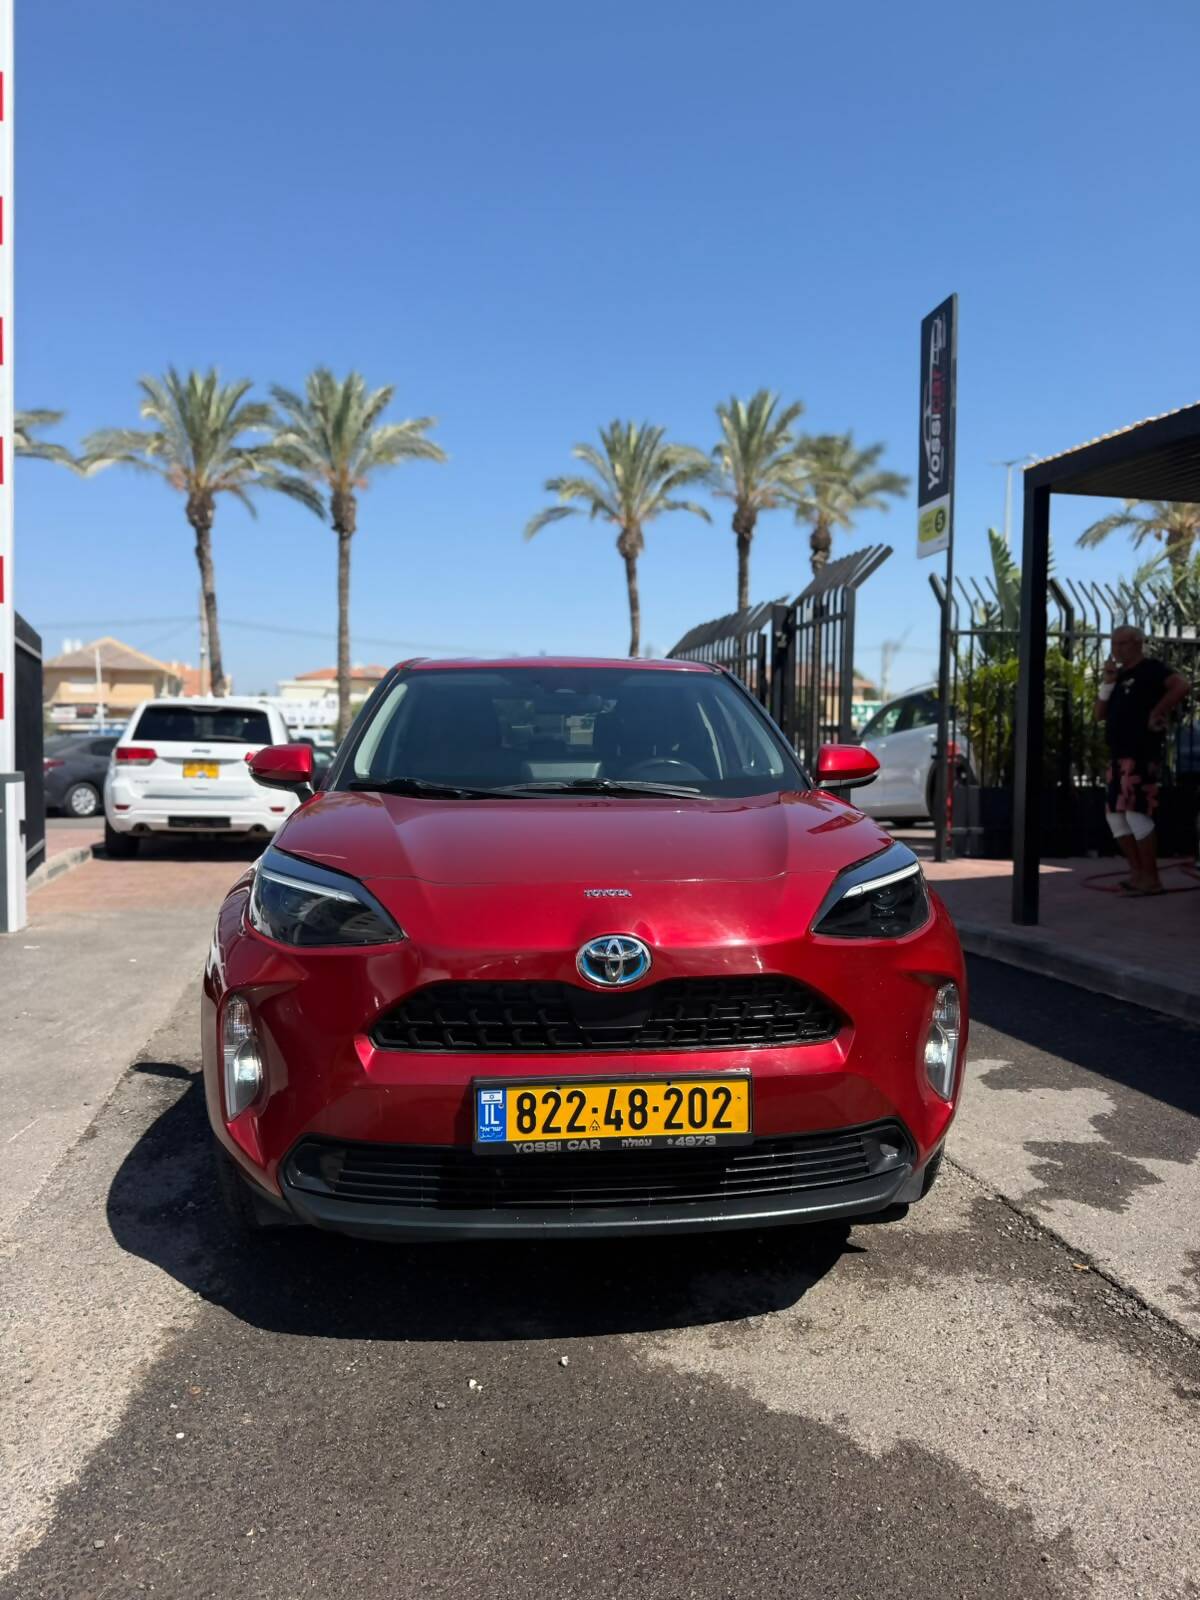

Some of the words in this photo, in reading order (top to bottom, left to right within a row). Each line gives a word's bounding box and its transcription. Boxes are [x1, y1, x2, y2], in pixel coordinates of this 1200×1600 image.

[584, 889, 632, 897] TOYOTA
[485, 1104, 500, 1124] IL
[513, 1141, 561, 1153] YOSSI
[567, 1139, 600, 1150] CAR
